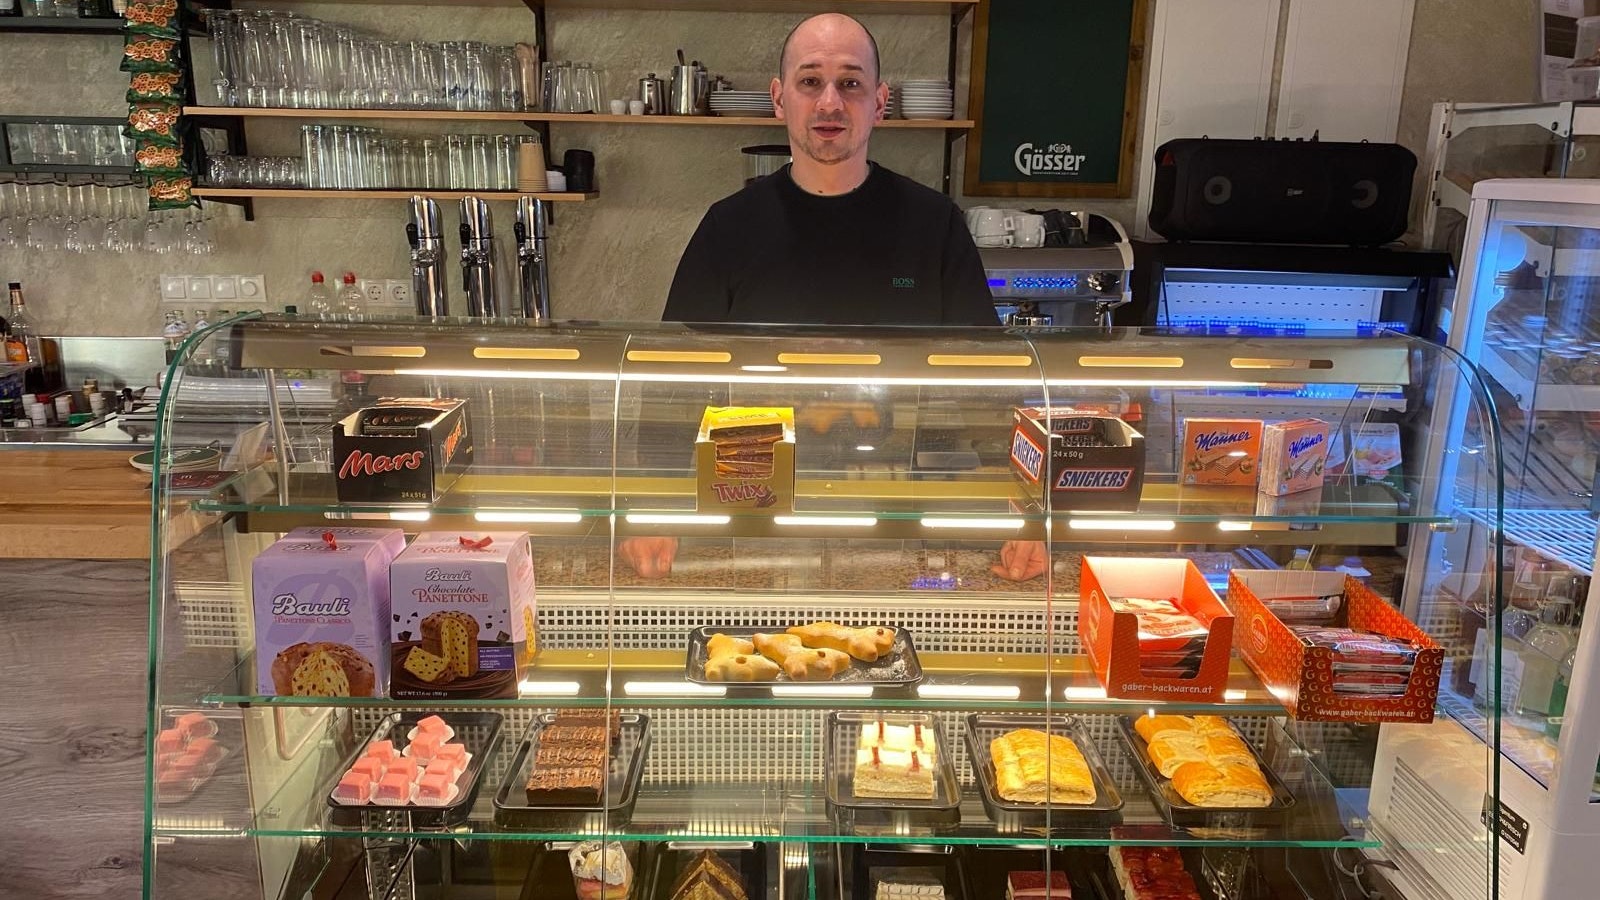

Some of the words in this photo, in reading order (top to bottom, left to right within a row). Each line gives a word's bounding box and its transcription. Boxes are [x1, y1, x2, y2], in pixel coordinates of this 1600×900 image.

[1014, 142, 1085, 175] Gösser
[1195, 431, 1252, 451] Manner
[1288, 433, 1324, 459] Manner
[1012, 431, 1042, 479] SNICKERS
[1053, 450, 1062, 458] 24
[338, 449, 425, 480] Mars
[1059, 470, 1130, 487] SNICKERS
[711, 480, 768, 503] Twix
[425, 567, 472, 581] Bauli
[412, 588, 489, 603] PANETTONE
[427, 584, 475, 594] Chocolate
[272, 593, 351, 616] Bauli
[1122, 682, 1214, 694] gaber-backwaren.at
[1320, 708, 1416, 719] www.gaber-backwaren.at
